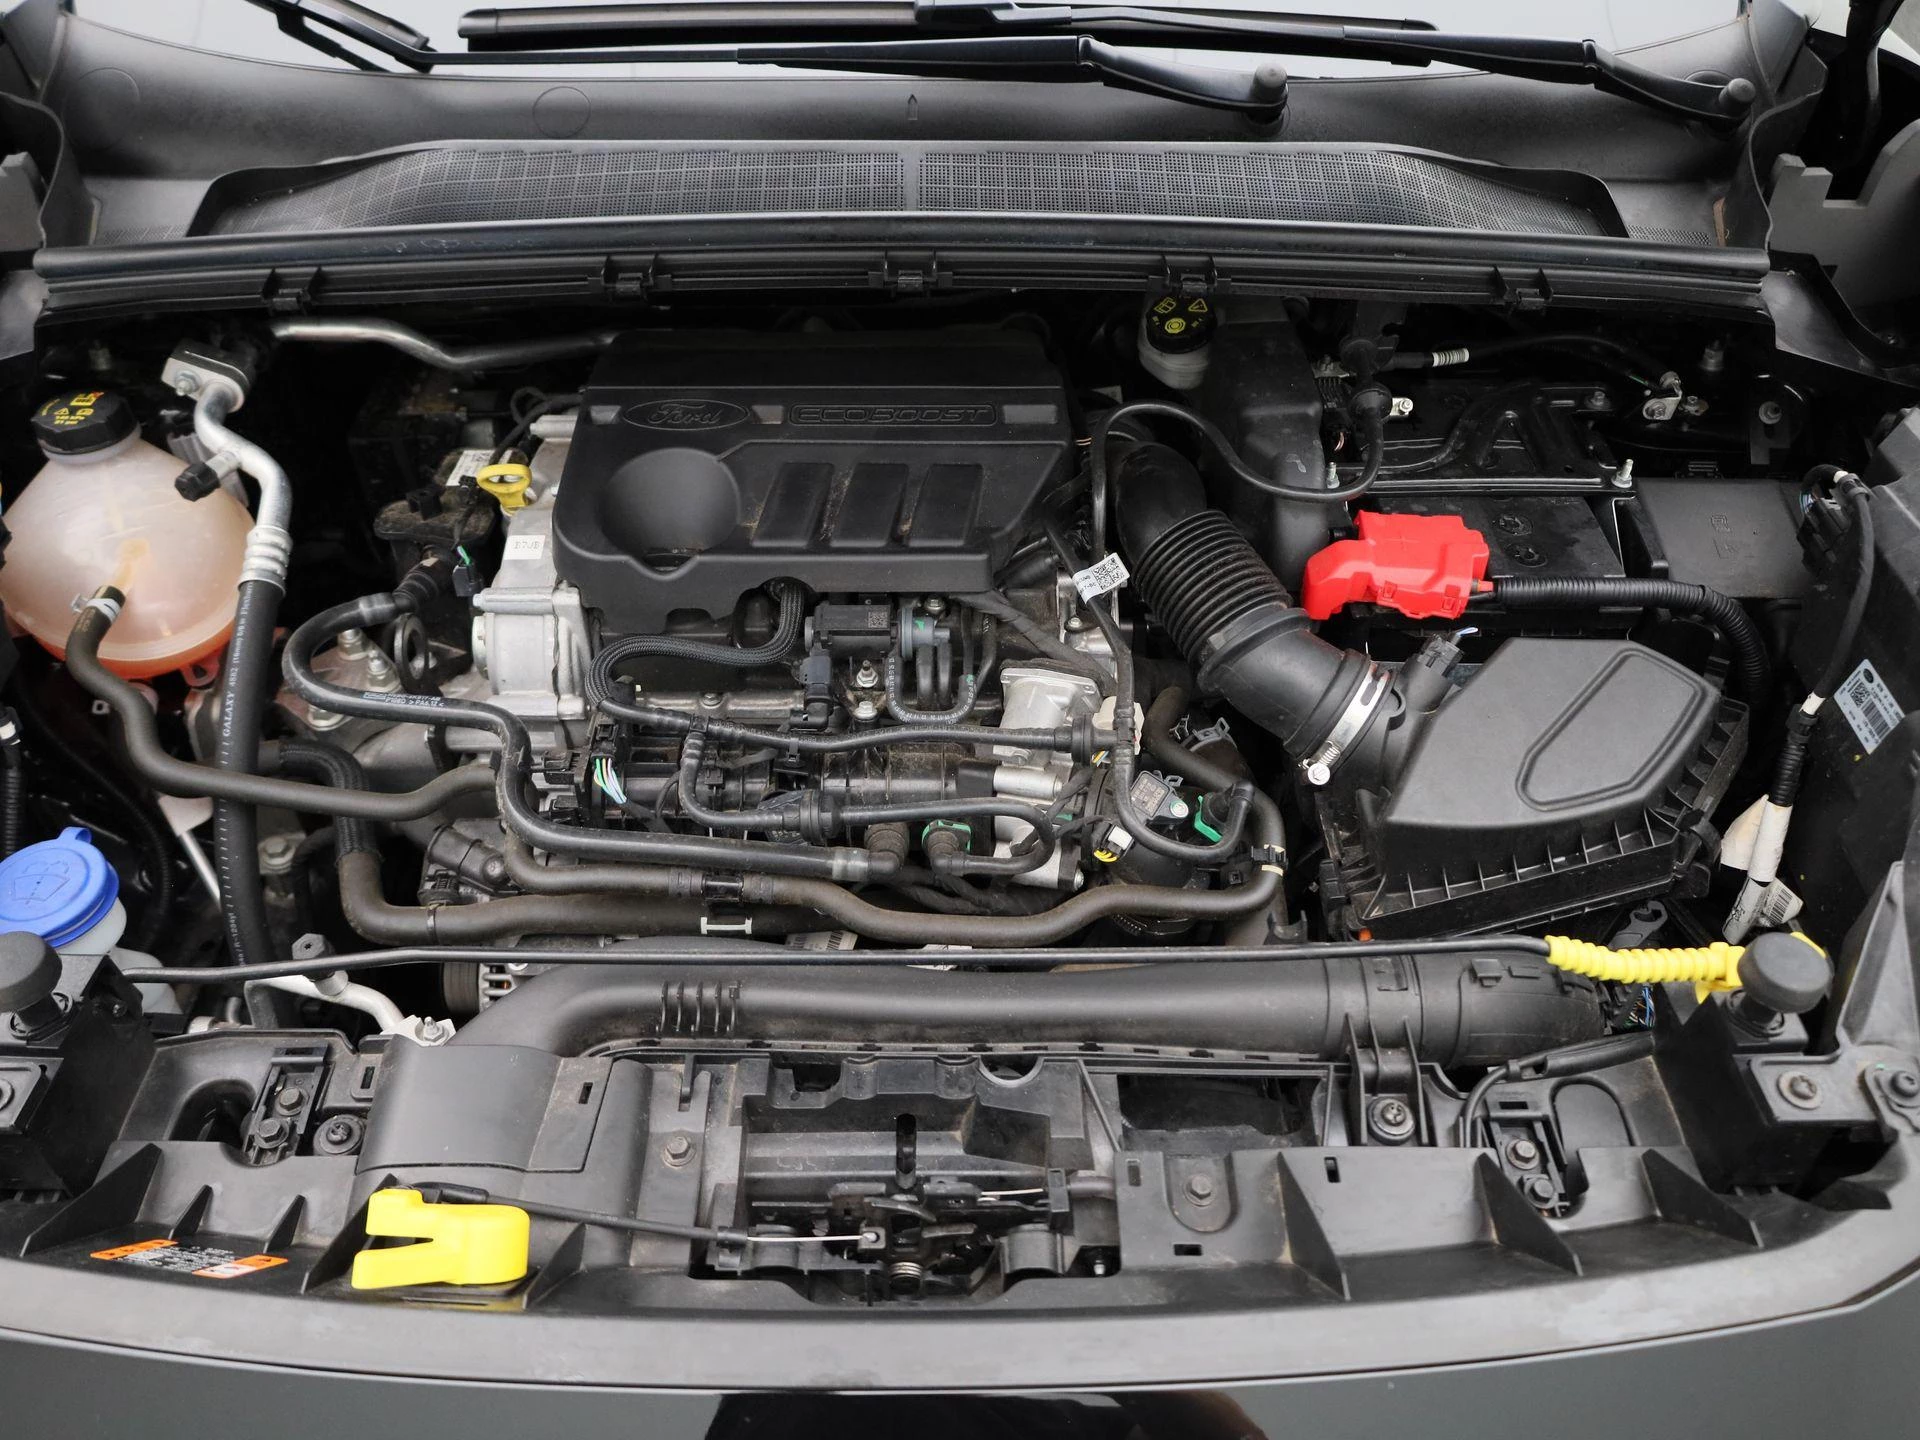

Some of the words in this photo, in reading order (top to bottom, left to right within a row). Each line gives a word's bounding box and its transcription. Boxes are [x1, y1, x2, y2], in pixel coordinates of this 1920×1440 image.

[649, 403, 724, 425] Ford
[797, 408, 989, 424] ECOBOOST
[222, 691, 235, 737] GALAXY
